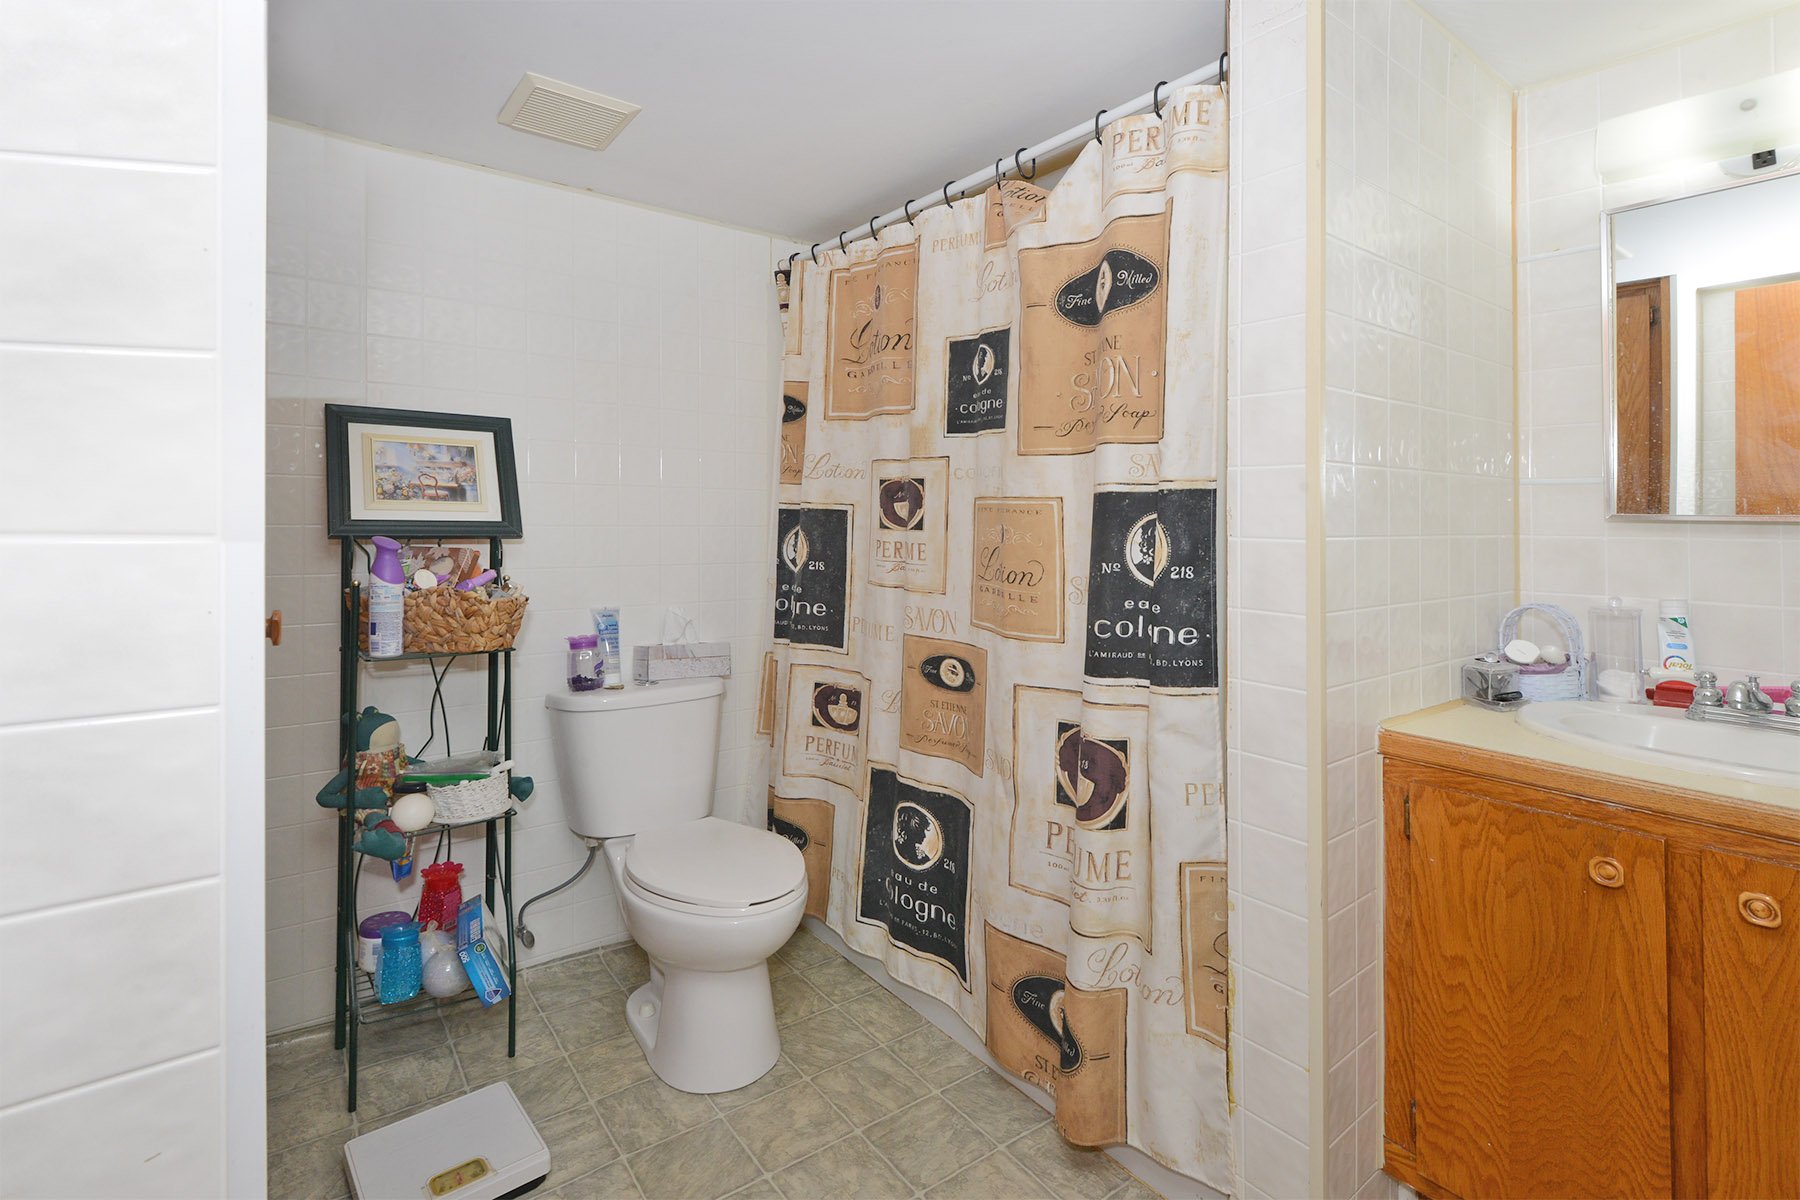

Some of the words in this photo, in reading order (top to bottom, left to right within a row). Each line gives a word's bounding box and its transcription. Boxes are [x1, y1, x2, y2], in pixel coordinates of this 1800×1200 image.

[1065, 294, 1092, 309] Fine
[1116, 270, 1153, 290] Milled
[804, 452, 865, 480] Lotion
[808, 560, 825, 571] 218
[1170, 566, 1194, 580] 218
[904, 605, 958, 635] SAVON
[918, 881, 938, 894] de
[1021, 990, 1046, 1010] Fine
